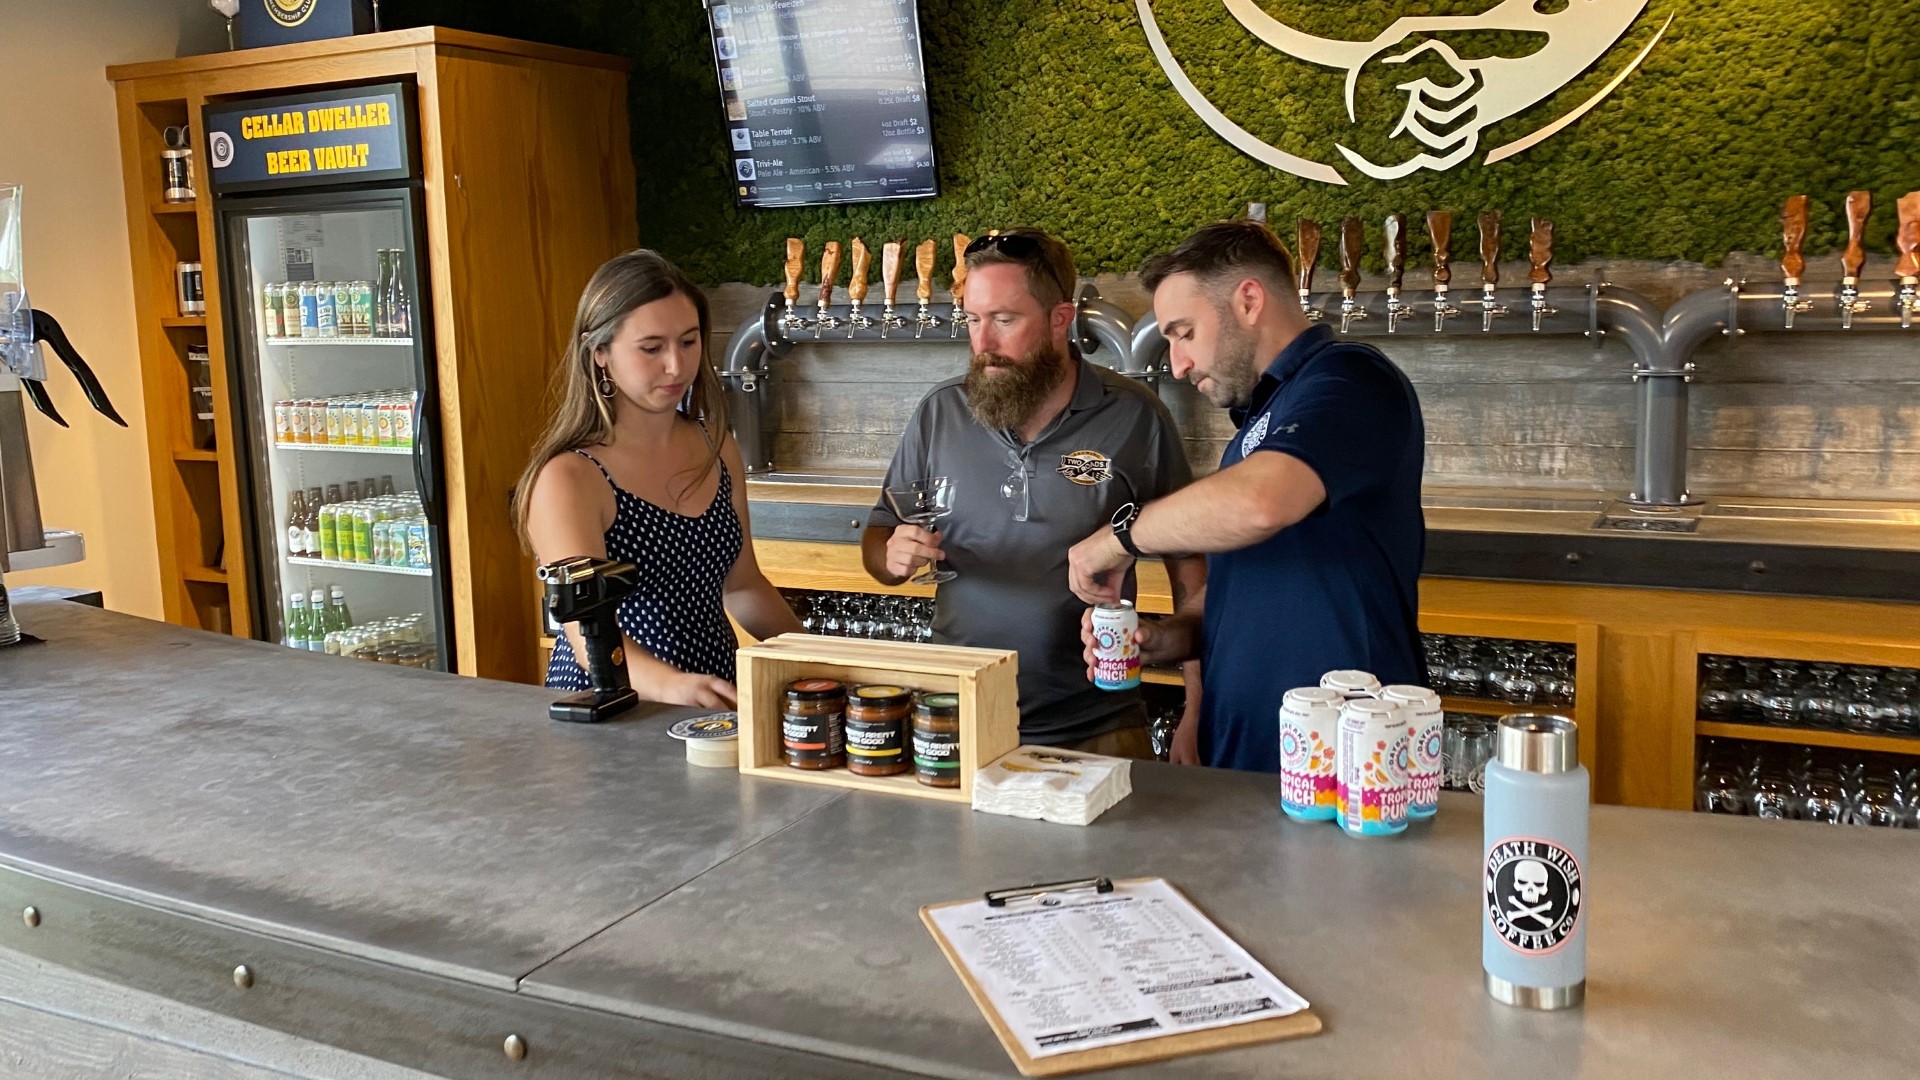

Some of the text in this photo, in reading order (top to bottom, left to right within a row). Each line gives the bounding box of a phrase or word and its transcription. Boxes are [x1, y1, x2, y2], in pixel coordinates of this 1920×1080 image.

[269, 0, 301, 20] MEMBERSHIP
[746, 94, 816, 108] Salted Caramel Stout
[895, 94, 912, 104] Draft
[912, 93, 921, 103] $8
[748, 103, 826, 117] Stout Pastry 10% ABV
[241, 102, 391, 140] CELLAR DWELLER
[893, 118, 909, 128] Draft
[909, 117, 918, 127] $2
[751, 127, 793, 138] Table Terroir
[882, 126, 925, 137] 12oz Bottle $3
[752, 134, 822, 149] Table Beer 3.7% ABV
[266, 143, 369, 175] BEER VAULT
[755, 158, 784, 169] Trivi-Ale
[757, 163, 855, 178] Pale Ale American 5.5% ABV
[1067, 458, 1104, 473] TWO ROADS
[1489, 841, 1580, 885] DEATH WISH
[1490, 904, 1557, 950] COFFEE
